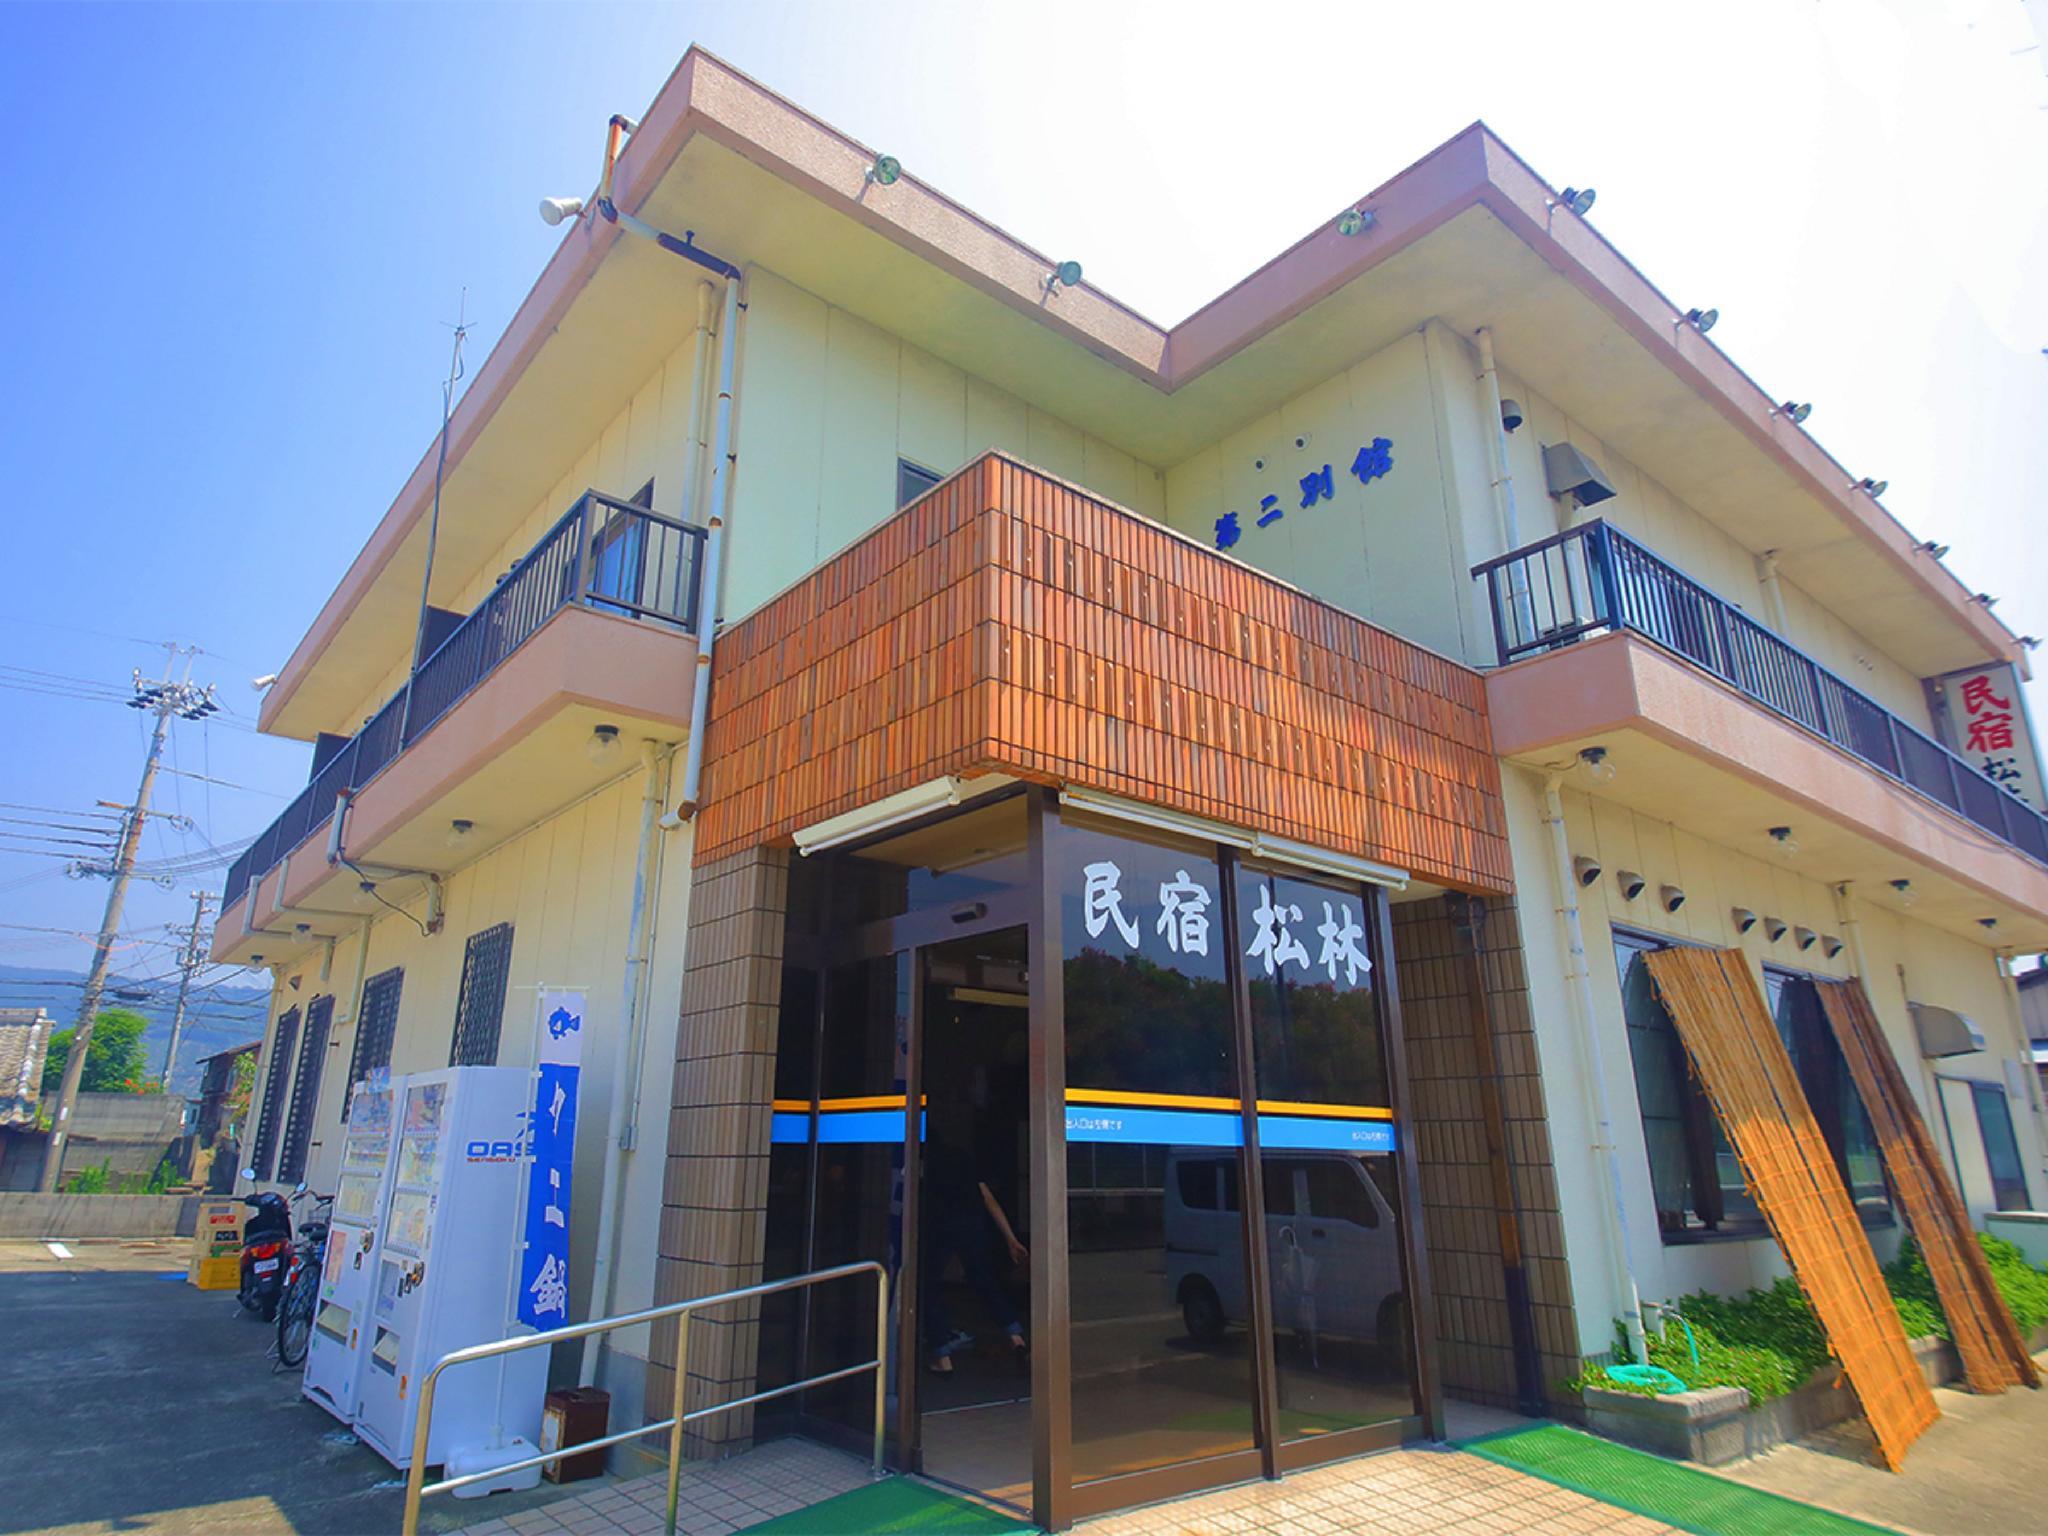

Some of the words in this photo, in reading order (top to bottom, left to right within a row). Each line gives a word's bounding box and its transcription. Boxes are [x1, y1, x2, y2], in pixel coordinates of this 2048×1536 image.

[1213, 436, 1394, 551] 第二別館
[1960, 674, 2030, 803] 民宿松
[1082, 860, 1373, 986] 民宿松林
